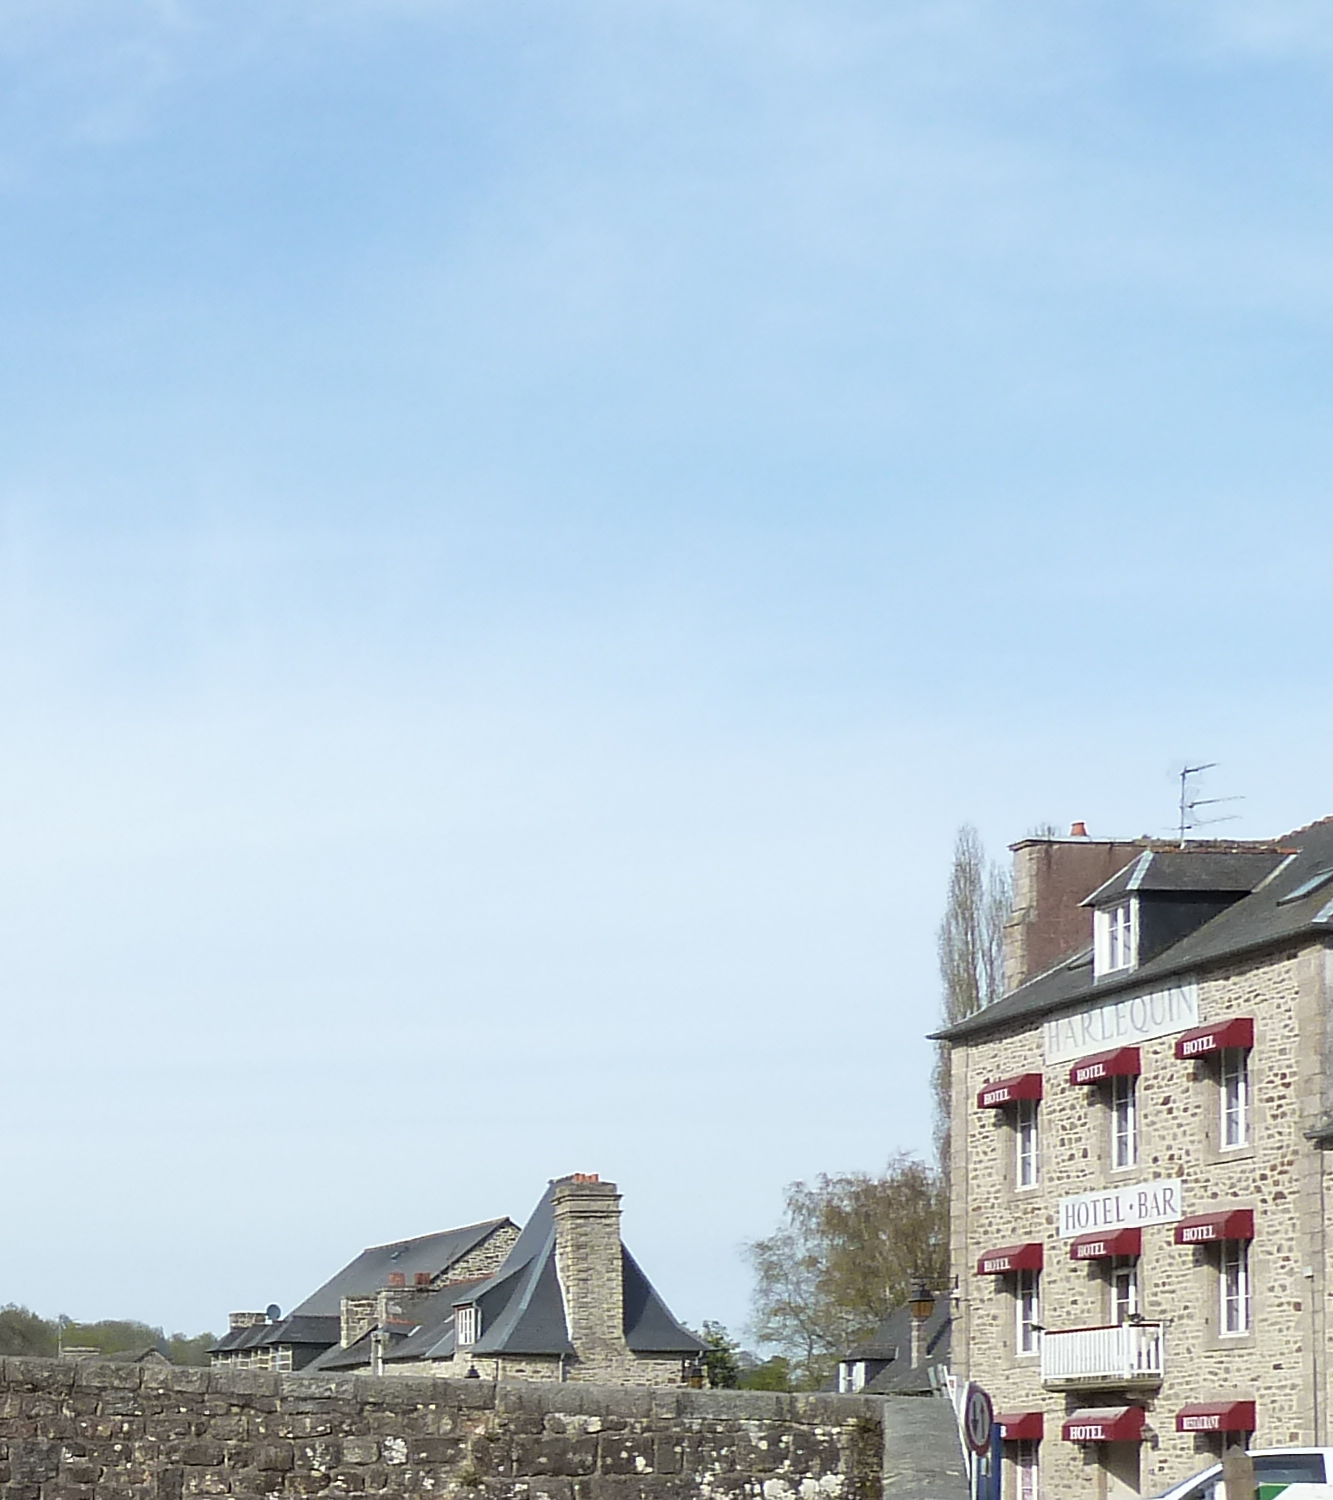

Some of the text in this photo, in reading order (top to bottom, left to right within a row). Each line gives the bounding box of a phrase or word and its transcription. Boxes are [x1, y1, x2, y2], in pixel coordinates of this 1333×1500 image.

[1048, 977, 1197, 1054] HARLEQUIN
[1183, 1035, 1216, 1055] HOTEL
[1076, 1063, 1106, 1081] HOTEL
[983, 1088, 1011, 1105] HOTEL
[1064, 1187, 1178, 1231] HOTEL BAR
[1182, 1225, 1216, 1241] HOTEL
[1077, 1242, 1106, 1258] HOTEL
[1069, 1425, 1105, 1440] HOTEL
